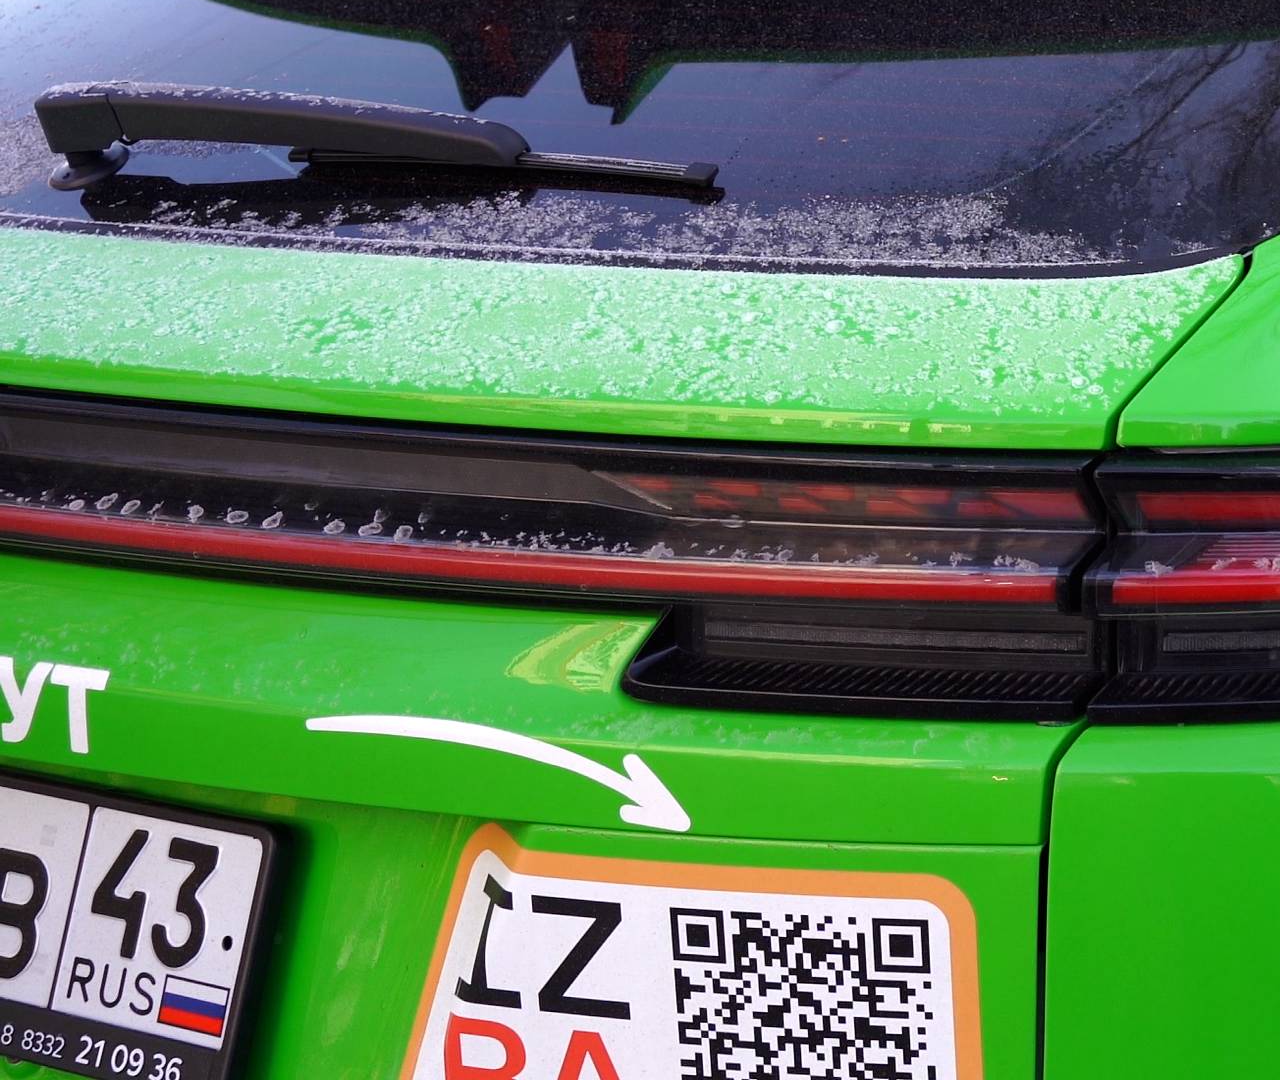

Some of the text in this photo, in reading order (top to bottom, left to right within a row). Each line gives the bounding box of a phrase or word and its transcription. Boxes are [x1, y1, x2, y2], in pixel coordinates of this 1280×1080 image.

[91, 829, 219, 968] 43
[66, 957, 156, 1016] RUS
[21, 1029, 65, 1058] 8332
[75, 1035, 105, 1068] 21
[111, 1044, 145, 1076] 09
[148, 1053, 183, 1080] 36
